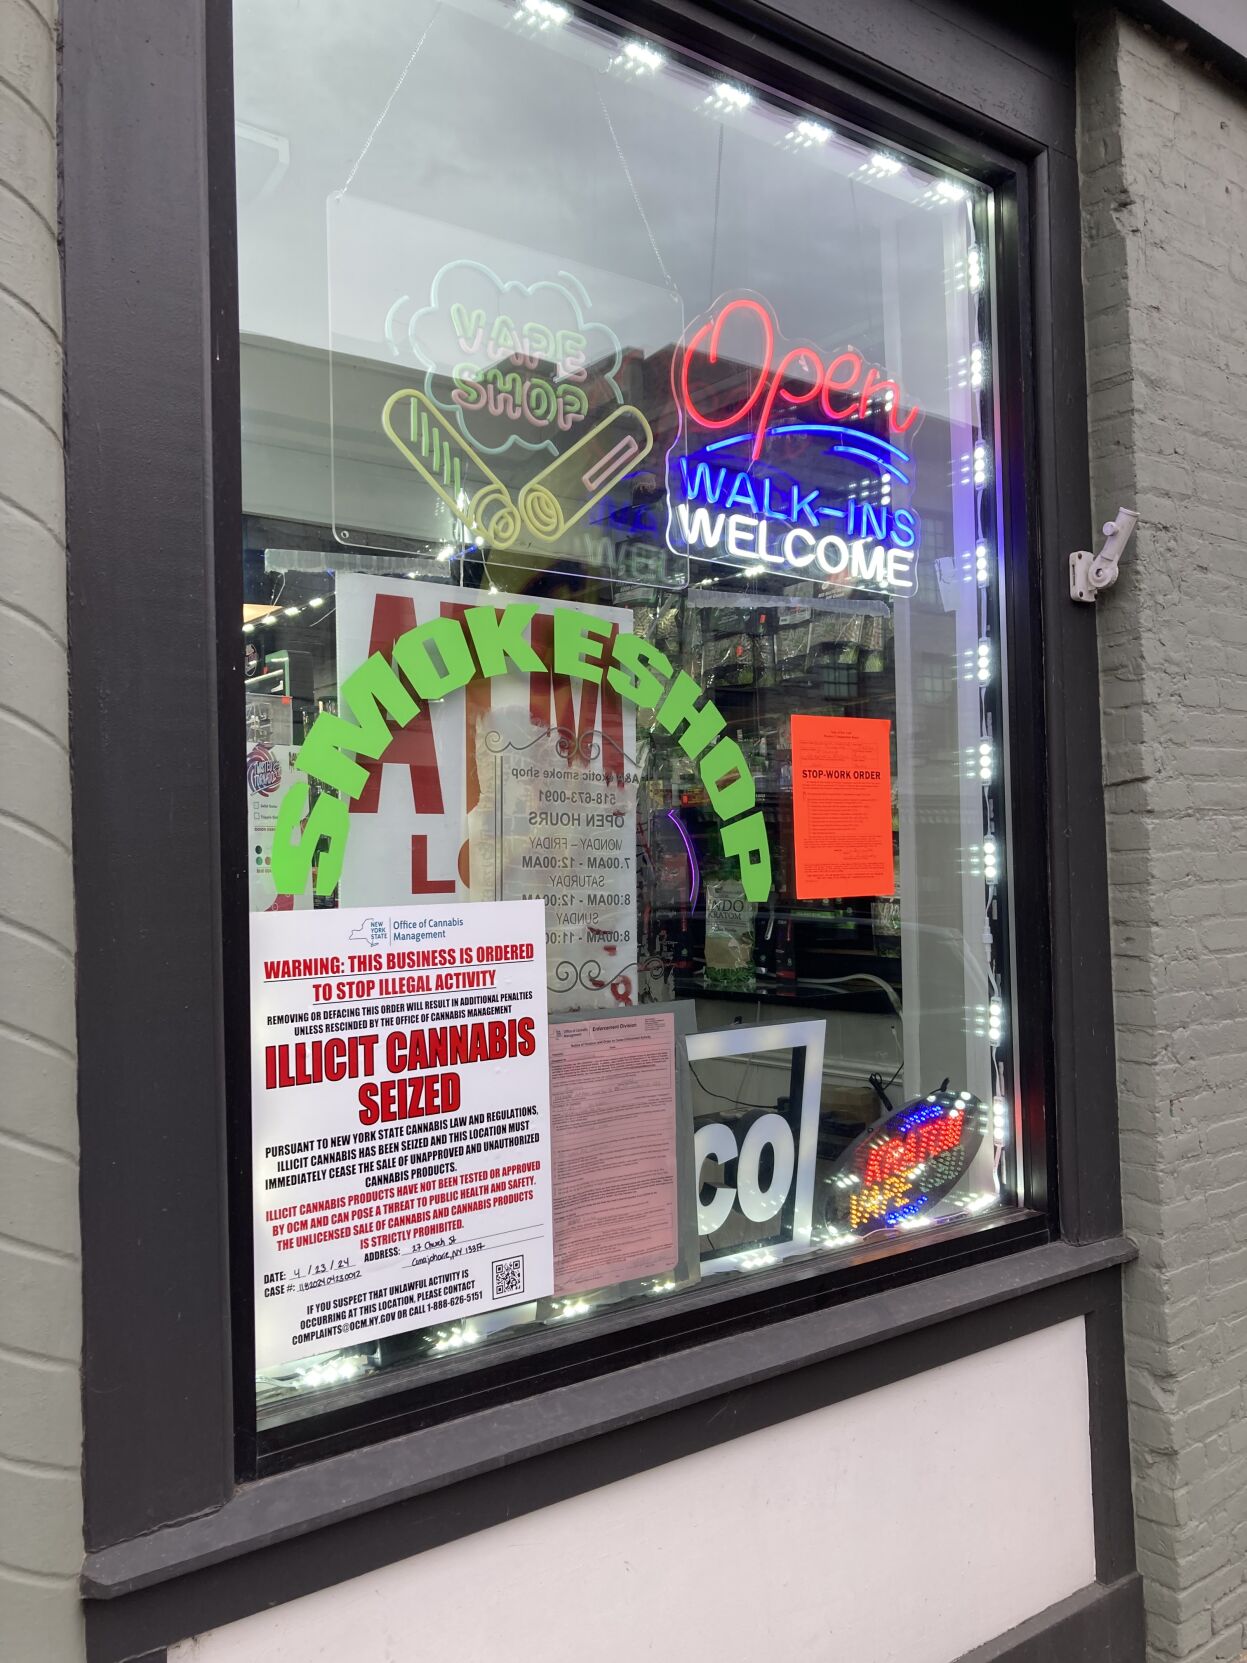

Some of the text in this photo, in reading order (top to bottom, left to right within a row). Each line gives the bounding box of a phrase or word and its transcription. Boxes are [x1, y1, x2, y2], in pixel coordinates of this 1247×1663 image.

[451, 303, 587, 382] VAPE
[452, 363, 588, 430] SHOP
[682, 299, 918, 461] Open
[681, 457, 915, 547] WALK-INS
[677, 504, 914, 588] WELCOME
[802, 770, 880, 780] STOP-WORK ORDER
[393, 918, 463, 929] Office of Cannabis
[393, 930, 445, 941] Management
[264, 943, 533, 978] WARNING: THIS BUSINESS IS ORDERED
[312, 969, 496, 1001] TO STOP ILLEGAL ACTIVITY
[267, 991, 532, 1025] REMOVING OR DEFACING THIS ORDER WILL RESULT IN ADDITIONAL PENALTIES
[294, 1005, 511, 1036] UNLESS RESCINDED BY THE OFFICE OF CANNABIS MANAGEMENT
[265, 1016, 535, 1089] ILLICIT CANNABIS
[358, 1072, 460, 1125] SEIZED
[266, 1105, 538, 1158] PURSUANT TO NEW YORK STATE CANNABIS LAW AND REGULATIONS,
[278, 1120, 529, 1172] ILLICIT CANNABIS HAS BEEN SEIZED AND THIS LOCATION MUST
[265, 1133, 539, 1190] IMMEDIATELY CEASE THE SALE OF UNAPPROVED AND UNAUTHORIZED
[365, 1162, 457, 1187] CANNABIS PRODUCTS.
[266, 1161, 540, 1221] ILLICIT CANNABIS PRODUCTS HAVE NOT BEEN TESTED OR APPROVED
[272, 1175, 536, 1236] BY OCM AND CAN POSE A THREAT TO PUBLIC HEALTH AND SAFETY.
[277, 1190, 533, 1251] THE UNLICENSED SALE OF CANNABIS AND CANNABIS PRODUCTS
[360, 1219, 463, 1249] IS STRICTLY PROHIBITED.
[264, 1271, 286, 1284] DATE:
[364, 1246, 400, 1262] ADDRESS:
[264, 1285, 284, 1298] CASE
[300, 1280, 475, 1329] OCCURRING AT THIS LOCATION, PLEASE CONTACT
[307, 1269, 468, 1314] IF YOU SUSPECT THAT UNLAWFUL ACTIVITY IS
[292, 1291, 482, 1345] COMPLAINTS@OCM.NY.GOV OR CALL 1-888-626-5151
